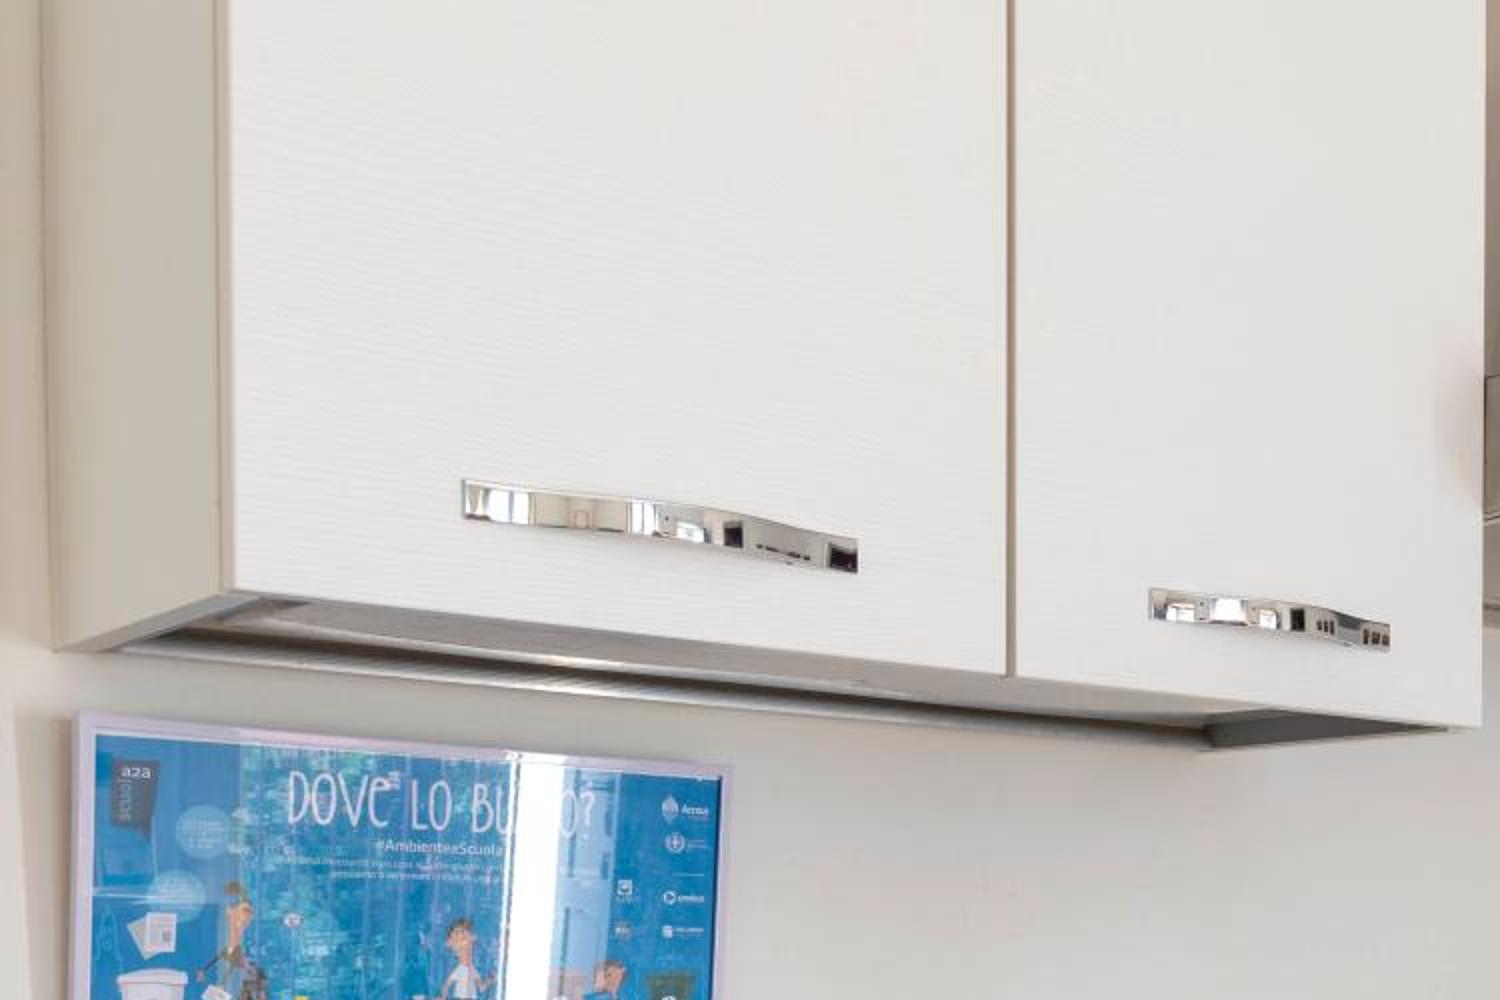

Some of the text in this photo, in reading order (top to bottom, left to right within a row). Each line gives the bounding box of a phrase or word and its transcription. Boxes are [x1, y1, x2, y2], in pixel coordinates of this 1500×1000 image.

[121, 766, 152, 779] a2a
[411, 778, 452, 832] LO
[471, 782, 596, 840] BUO?
